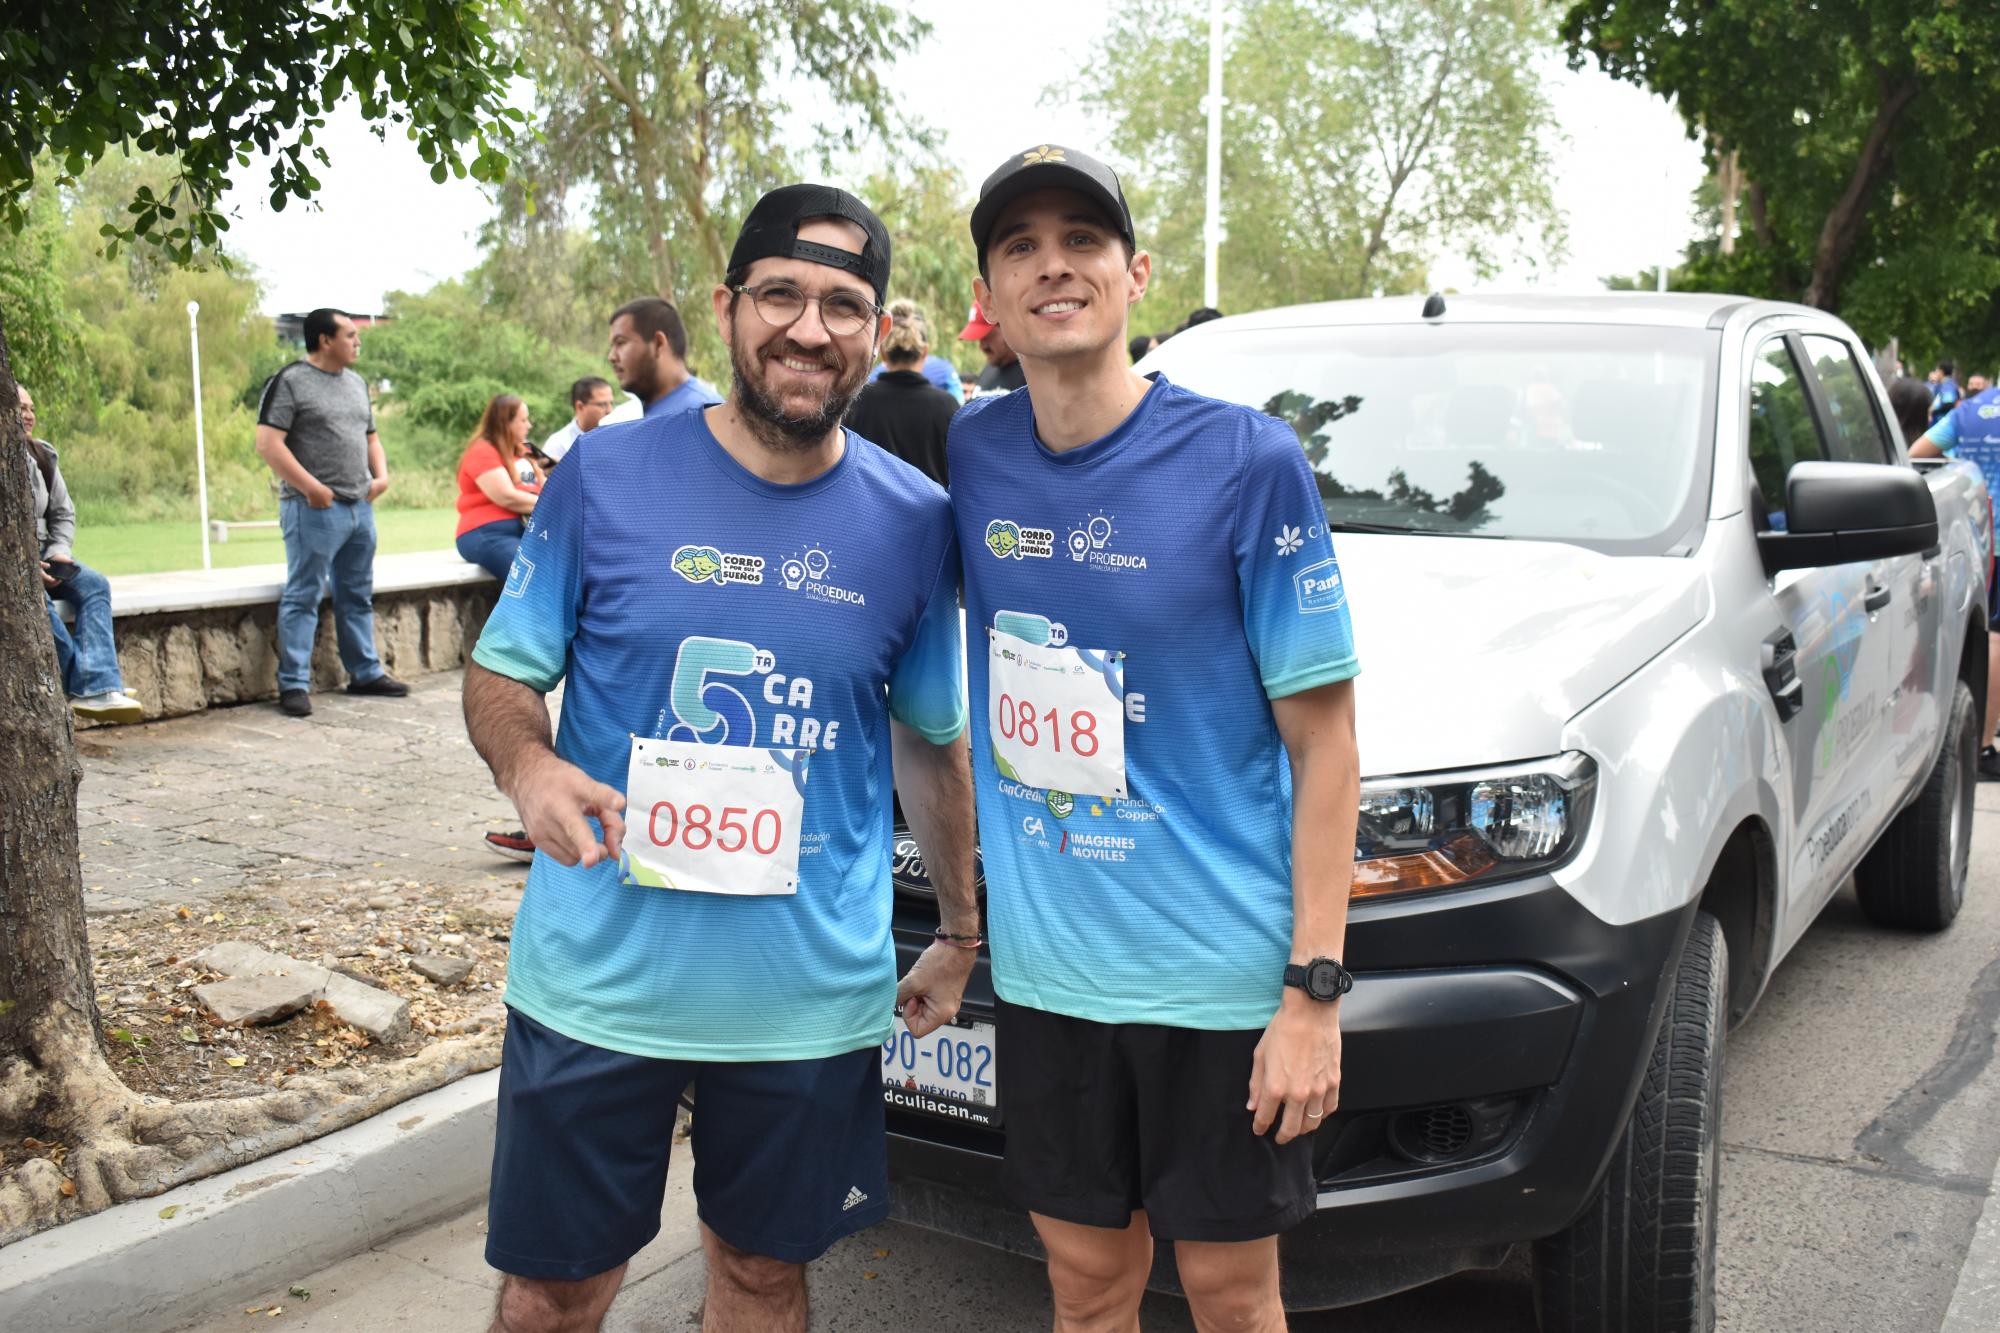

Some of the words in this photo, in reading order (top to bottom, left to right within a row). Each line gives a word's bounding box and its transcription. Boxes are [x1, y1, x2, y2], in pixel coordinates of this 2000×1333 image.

[1021, 530, 1052, 541] CORRO
[1020, 545, 1051, 556] SUEÑOS
[723, 556, 763, 568] CORRO
[1089, 551, 1147, 569] PROEDUCA
[723, 570, 760, 582] SUEÑOS
[806, 581, 865, 606] PROEDUCA
[1050, 628, 1065, 640] TA
[755, 655, 773, 668] TA
[763, 673, 814, 709] CA
[771, 713, 840, 750] RRE
[999, 693, 1099, 758] 0818
[648, 801, 783, 855] 0850
[1071, 833, 1136, 850] IMAGENES
[800, 844, 823, 856] ppel
[1072, 848, 1126, 862] MOVILES
[920, 1084, 967, 1101] MÉXICO
